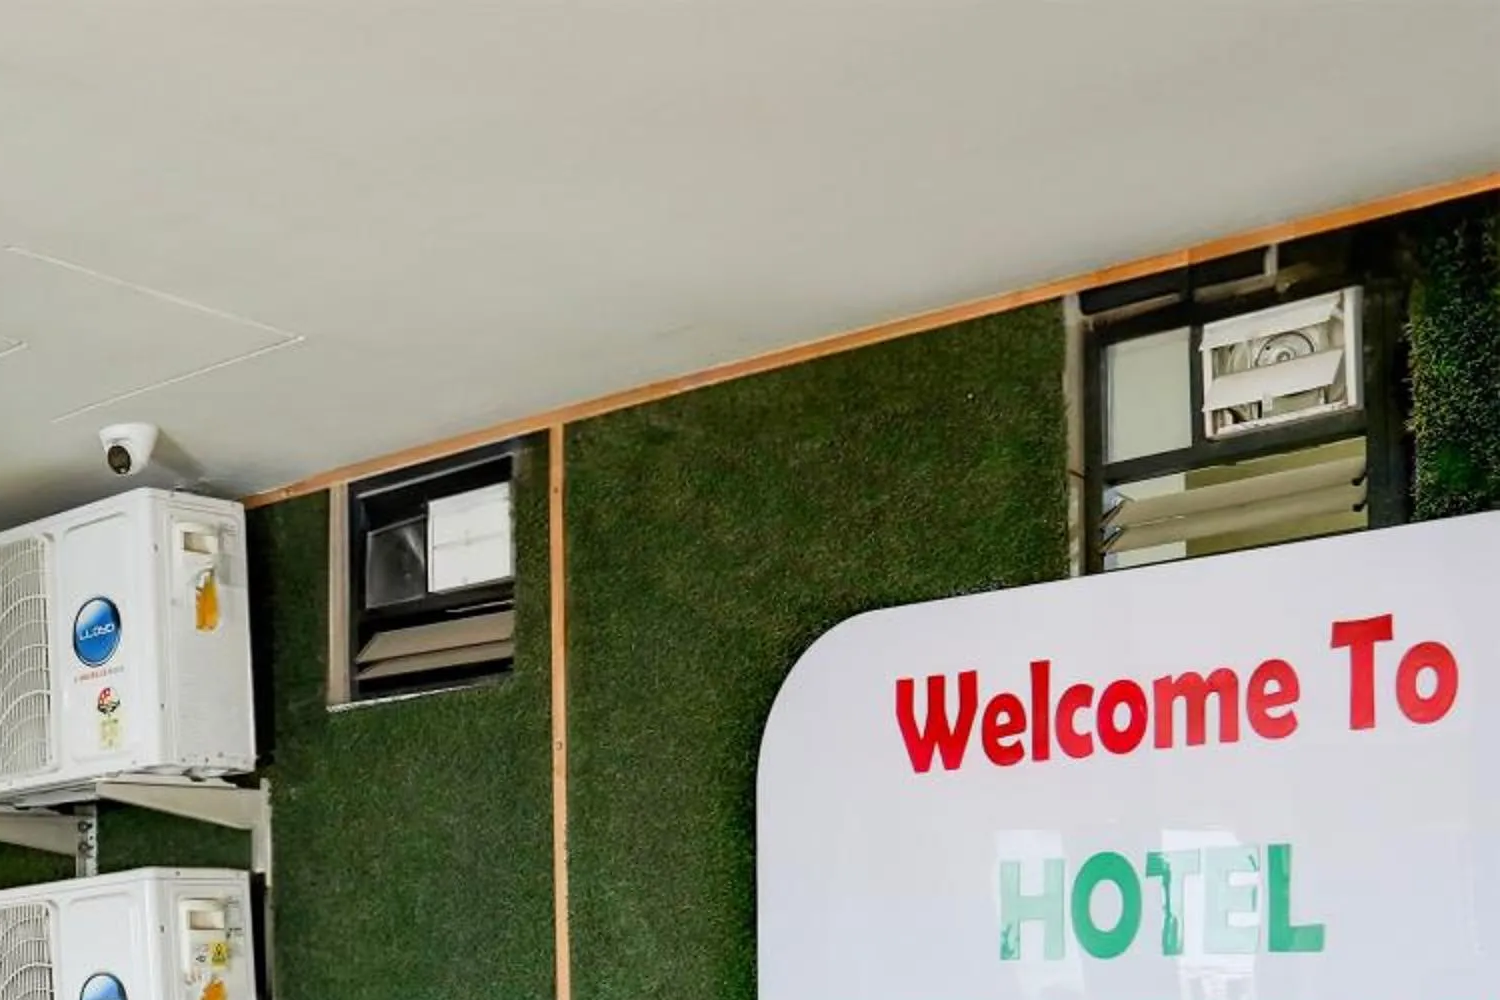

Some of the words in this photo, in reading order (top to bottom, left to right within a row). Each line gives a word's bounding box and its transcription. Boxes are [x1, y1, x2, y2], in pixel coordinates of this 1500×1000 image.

[896, 658, 1300, 773] Welcome
[1330, 614, 1459, 731] To
[999, 843, 1326, 960] HOTEL
